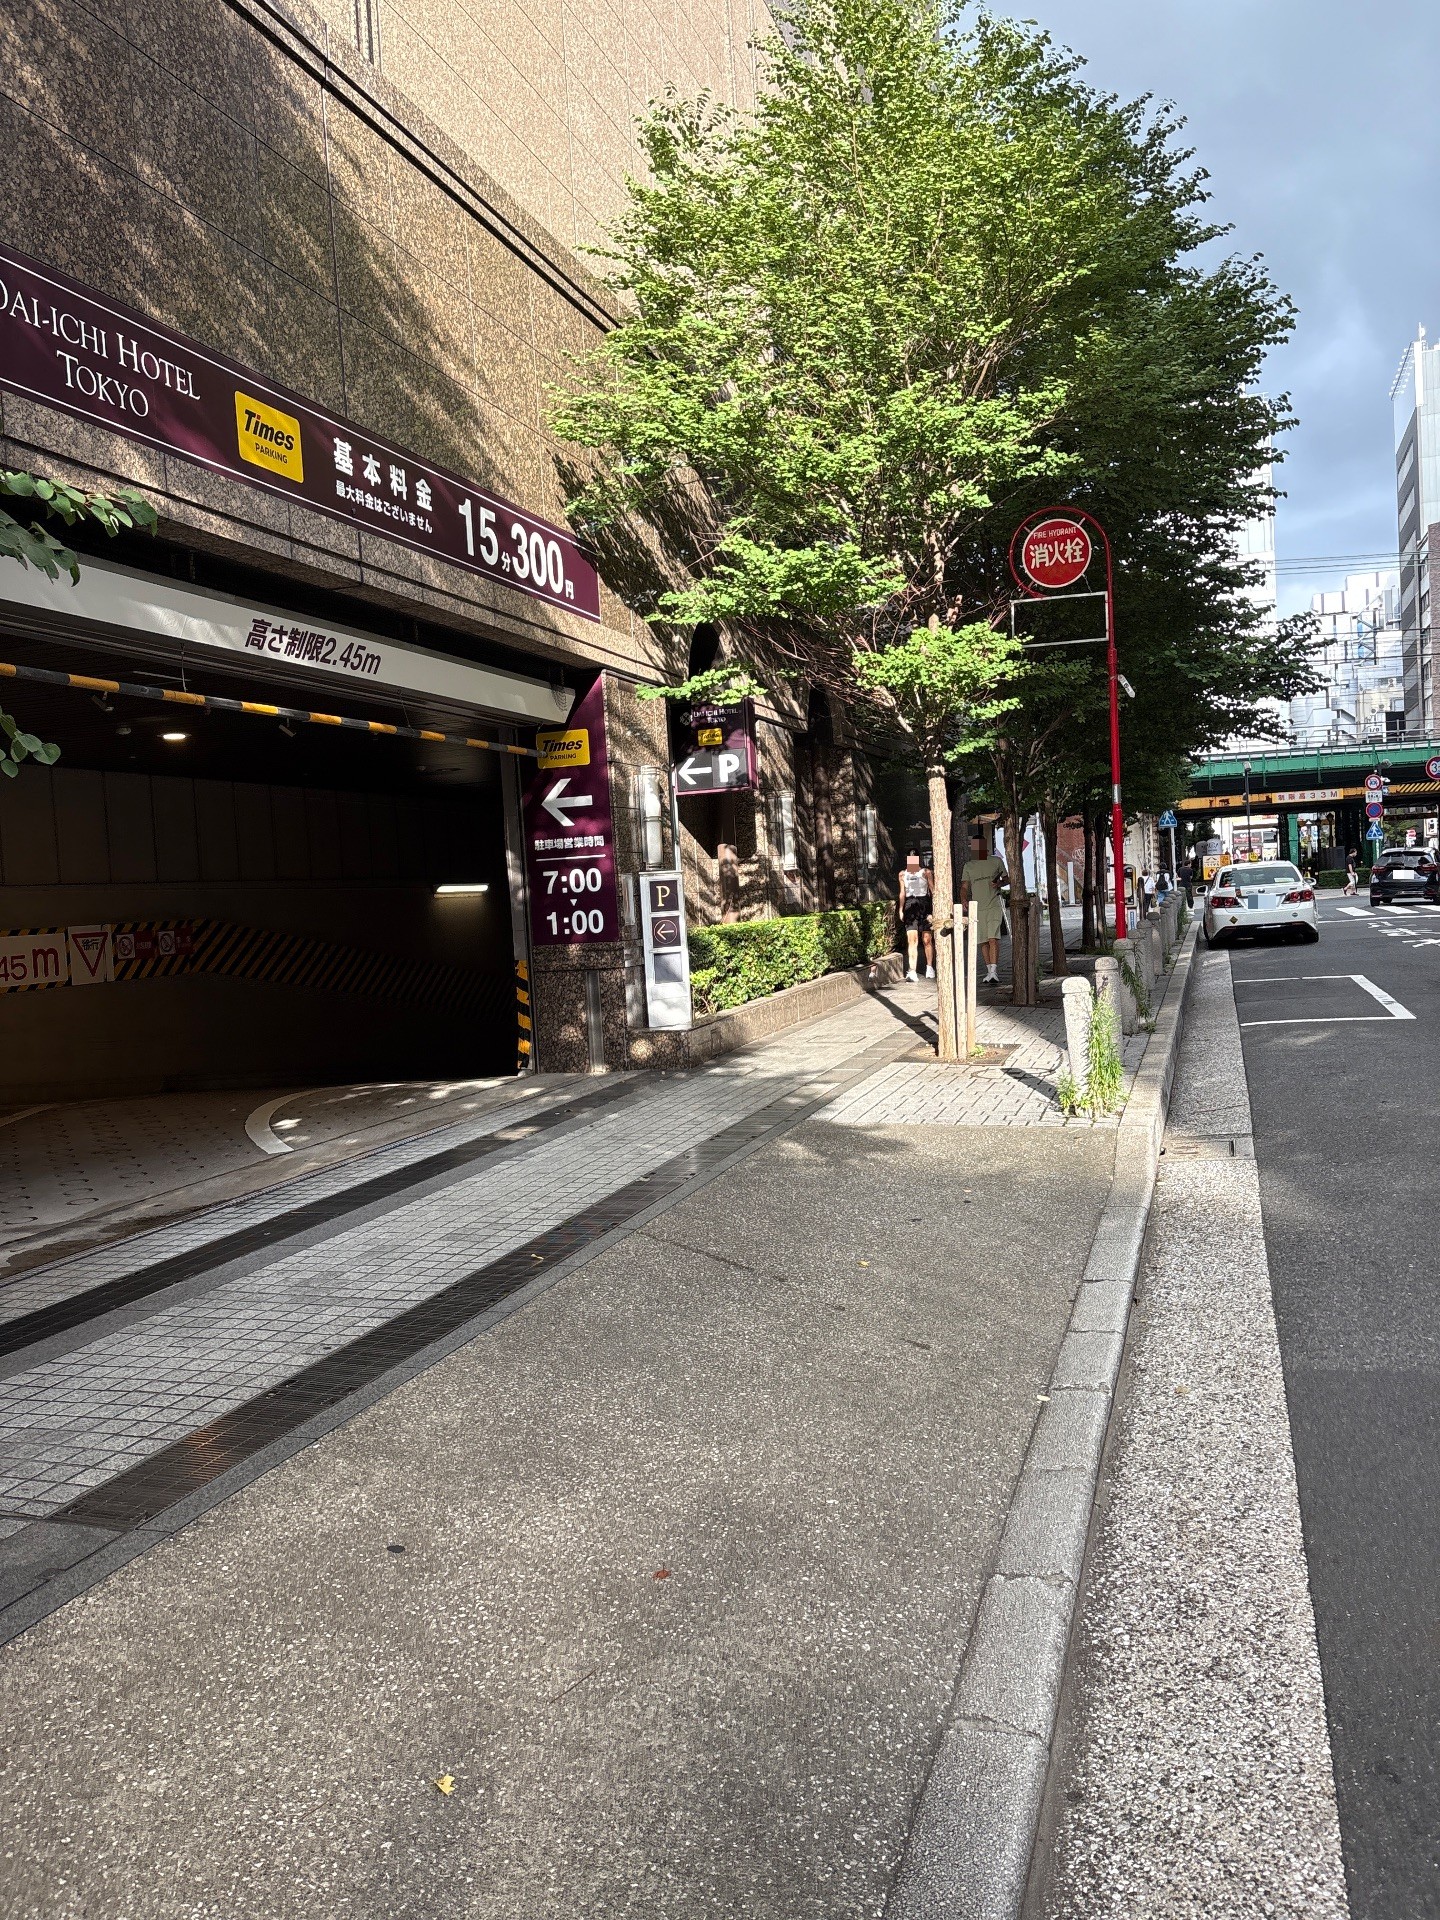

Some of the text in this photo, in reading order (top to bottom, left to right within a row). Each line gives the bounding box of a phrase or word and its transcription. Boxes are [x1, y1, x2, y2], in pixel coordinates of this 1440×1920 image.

[116, 332, 201, 401] HOTEL
[56, 350, 149, 418] TOKYO
[244, 409, 295, 451] Times
[254, 442, 288, 465] PARKING
[333, 437, 434, 512] 基本料金
[335, 480, 433, 534] 最大料金はございません
[1033, 526, 1077, 539] FIRE HYDRANT
[1029, 537, 1085, 569] 消火栓
[542, 739, 584, 753] Times
[550, 753, 577, 761] PARKING
[718, 753, 740, 783] P
[534, 835, 605, 851] 駐車場営業時間
[542, 868, 602, 895] 7:00
[656, 885, 671, 907] P
[546, 909, 605, 936] 1:00
